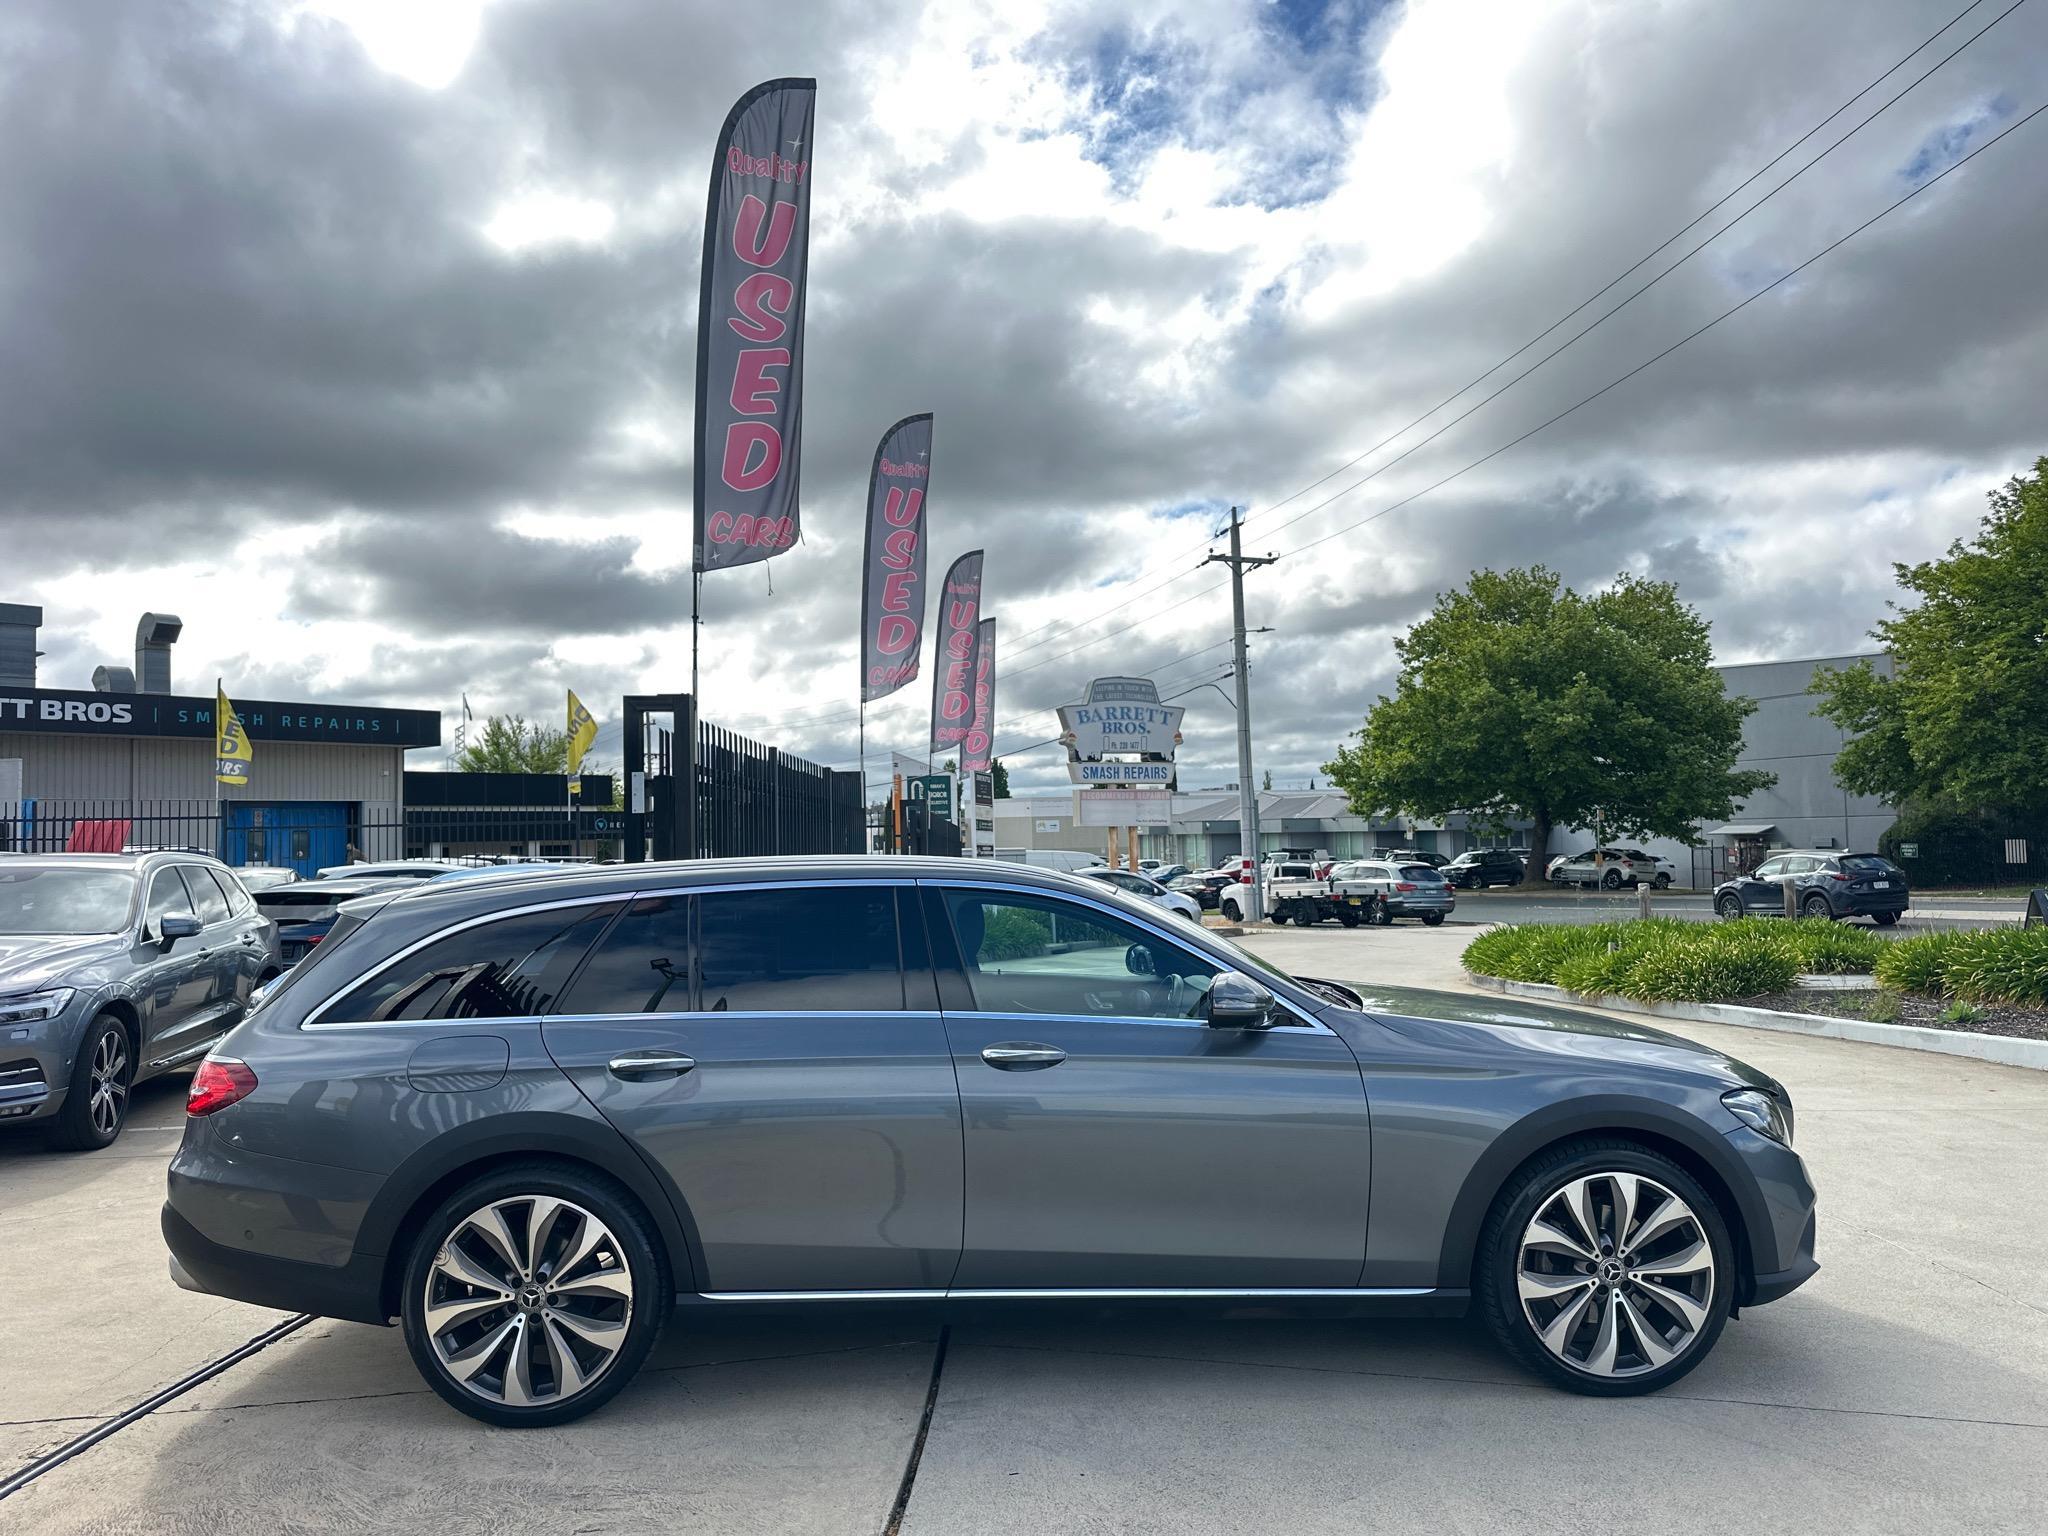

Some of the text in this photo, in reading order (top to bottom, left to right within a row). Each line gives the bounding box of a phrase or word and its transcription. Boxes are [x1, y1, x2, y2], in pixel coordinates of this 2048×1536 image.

[727, 145, 808, 186] Quality
[721, 194, 798, 492] USED
[880, 457, 929, 478] Quality
[707, 511, 794, 547] CARS
[876, 486, 924, 656] USED
[942, 600, 976, 720] USED
[40, 700, 133, 723] BROS
[178, 710, 263, 726] SMSH
[282, 715, 380, 731] REPAIRS
[1076, 706, 1174, 726] BARRETT
[1102, 721, 1150, 735] BROS.
[1083, 766, 1168, 780] SMASH REPAIRS
